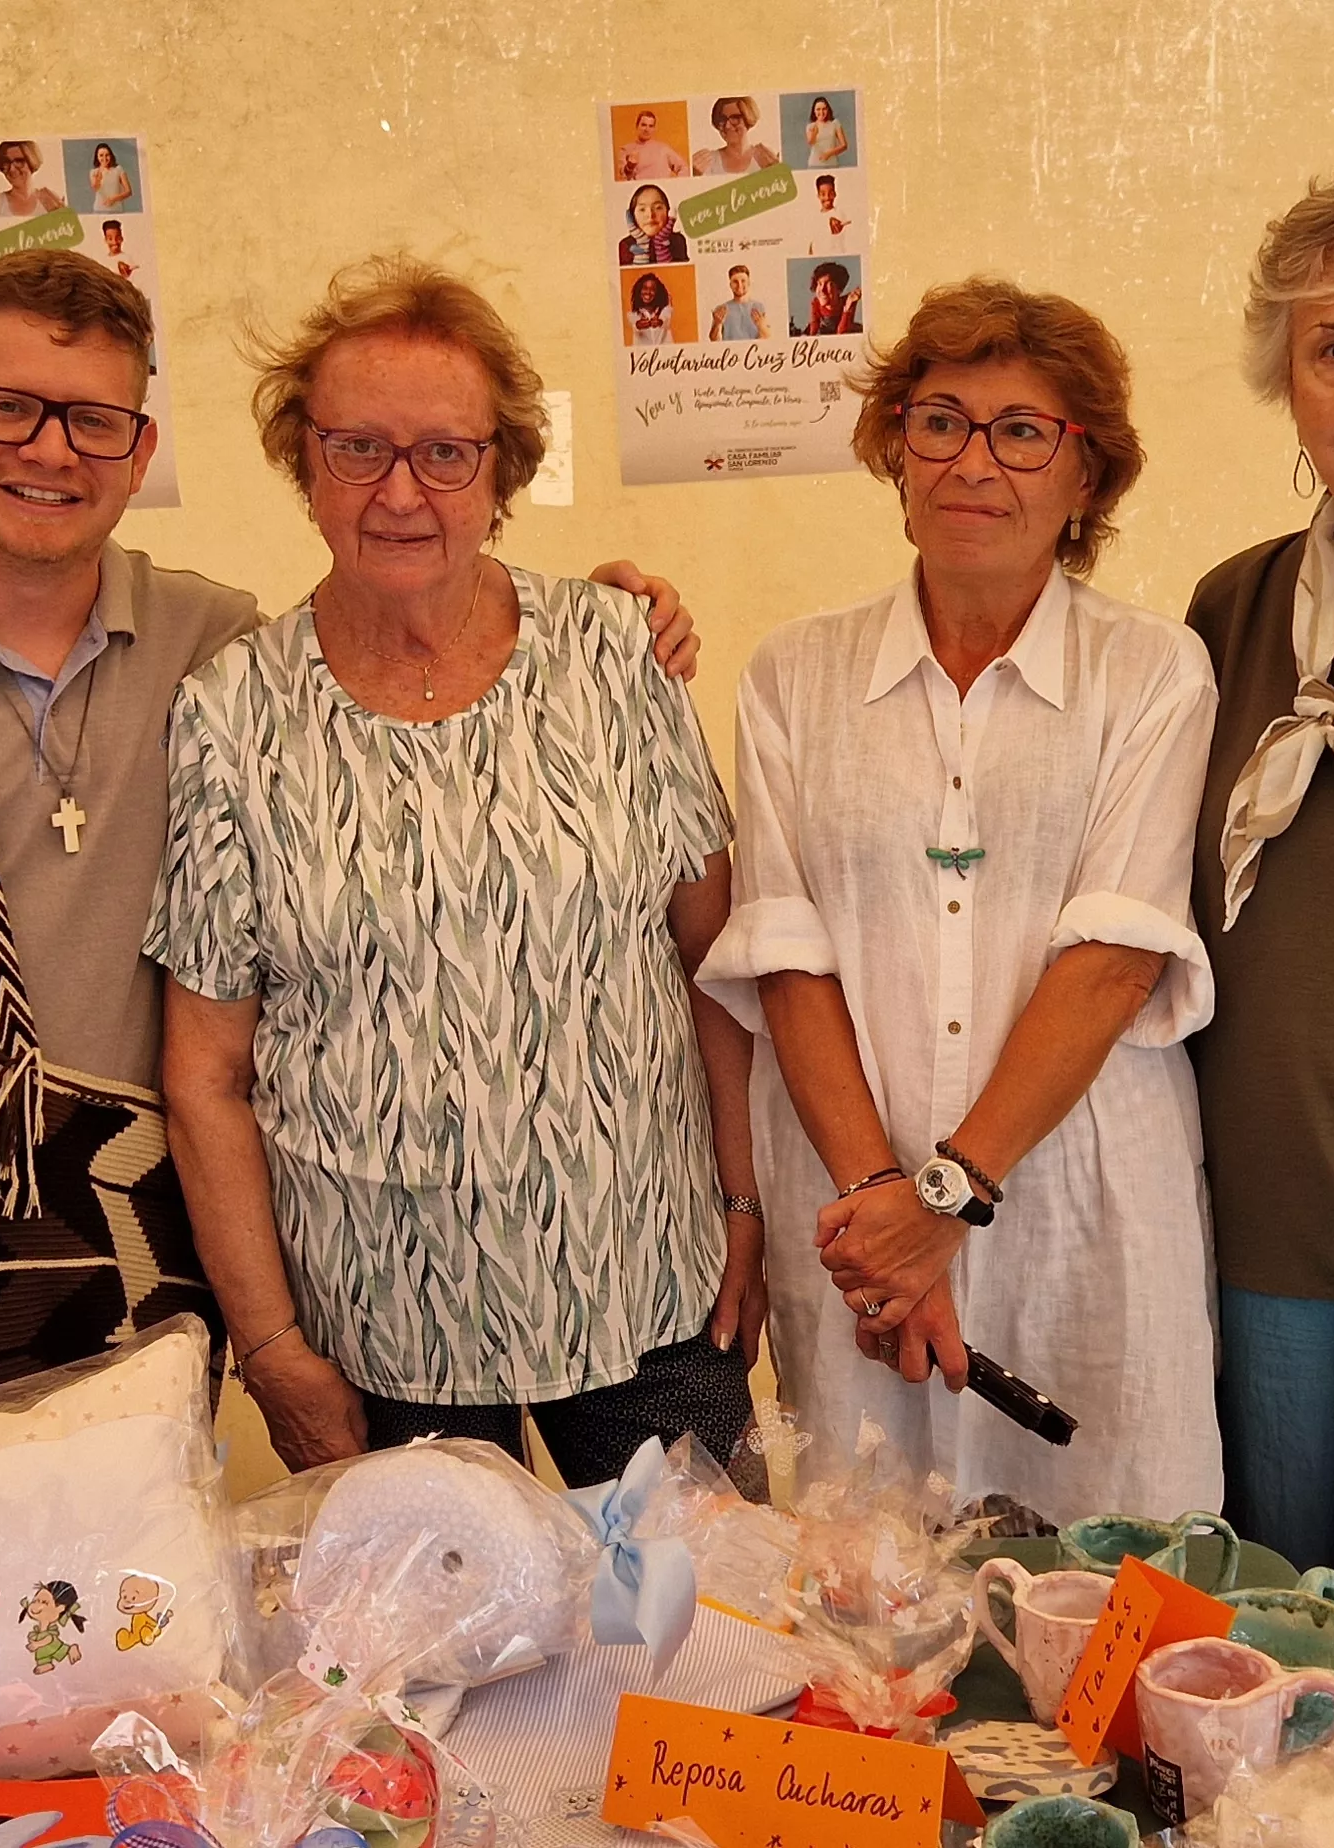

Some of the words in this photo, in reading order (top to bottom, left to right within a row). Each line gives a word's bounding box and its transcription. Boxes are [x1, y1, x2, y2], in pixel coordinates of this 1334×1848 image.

[715, 204, 728, 225] y
[730, 188, 748, 213] lo
[629, 347, 739, 377] Voluntariado
[744, 343, 787, 373] Cruz
[791, 340, 856, 368] Blanca
[635, 399, 666, 427] Ven
[668, 390, 683, 414] y
[1078, 1596, 1131, 1706] Tazas
[651, 1740, 746, 1806] Reposa
[776, 1764, 904, 1821] Cucharas
